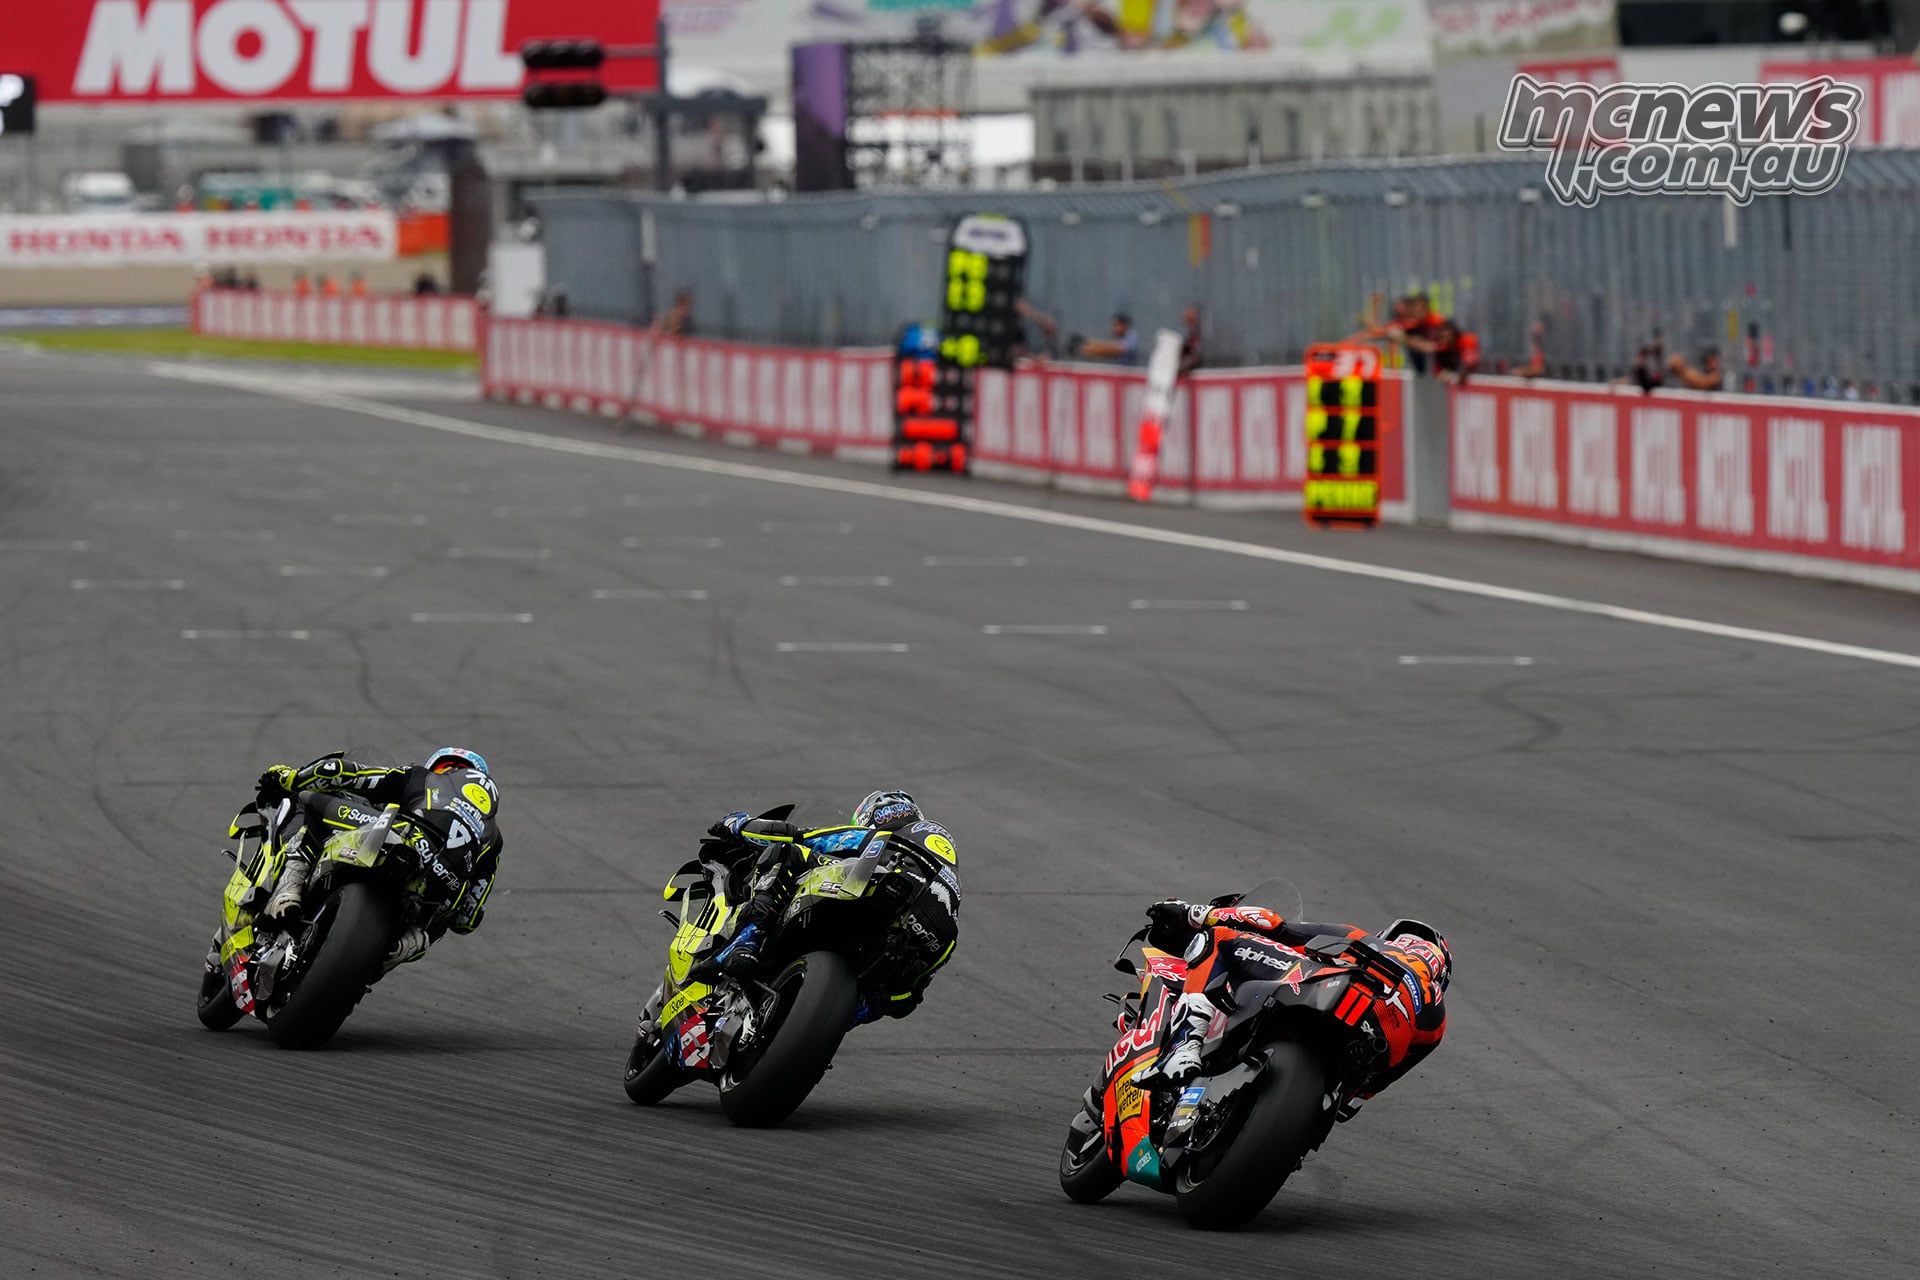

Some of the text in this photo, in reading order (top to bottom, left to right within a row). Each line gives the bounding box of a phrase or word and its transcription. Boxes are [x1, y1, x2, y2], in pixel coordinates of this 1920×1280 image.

[73, 0, 525, 95] MOTUL
[9, 222, 384, 254] HONDA HONDA
